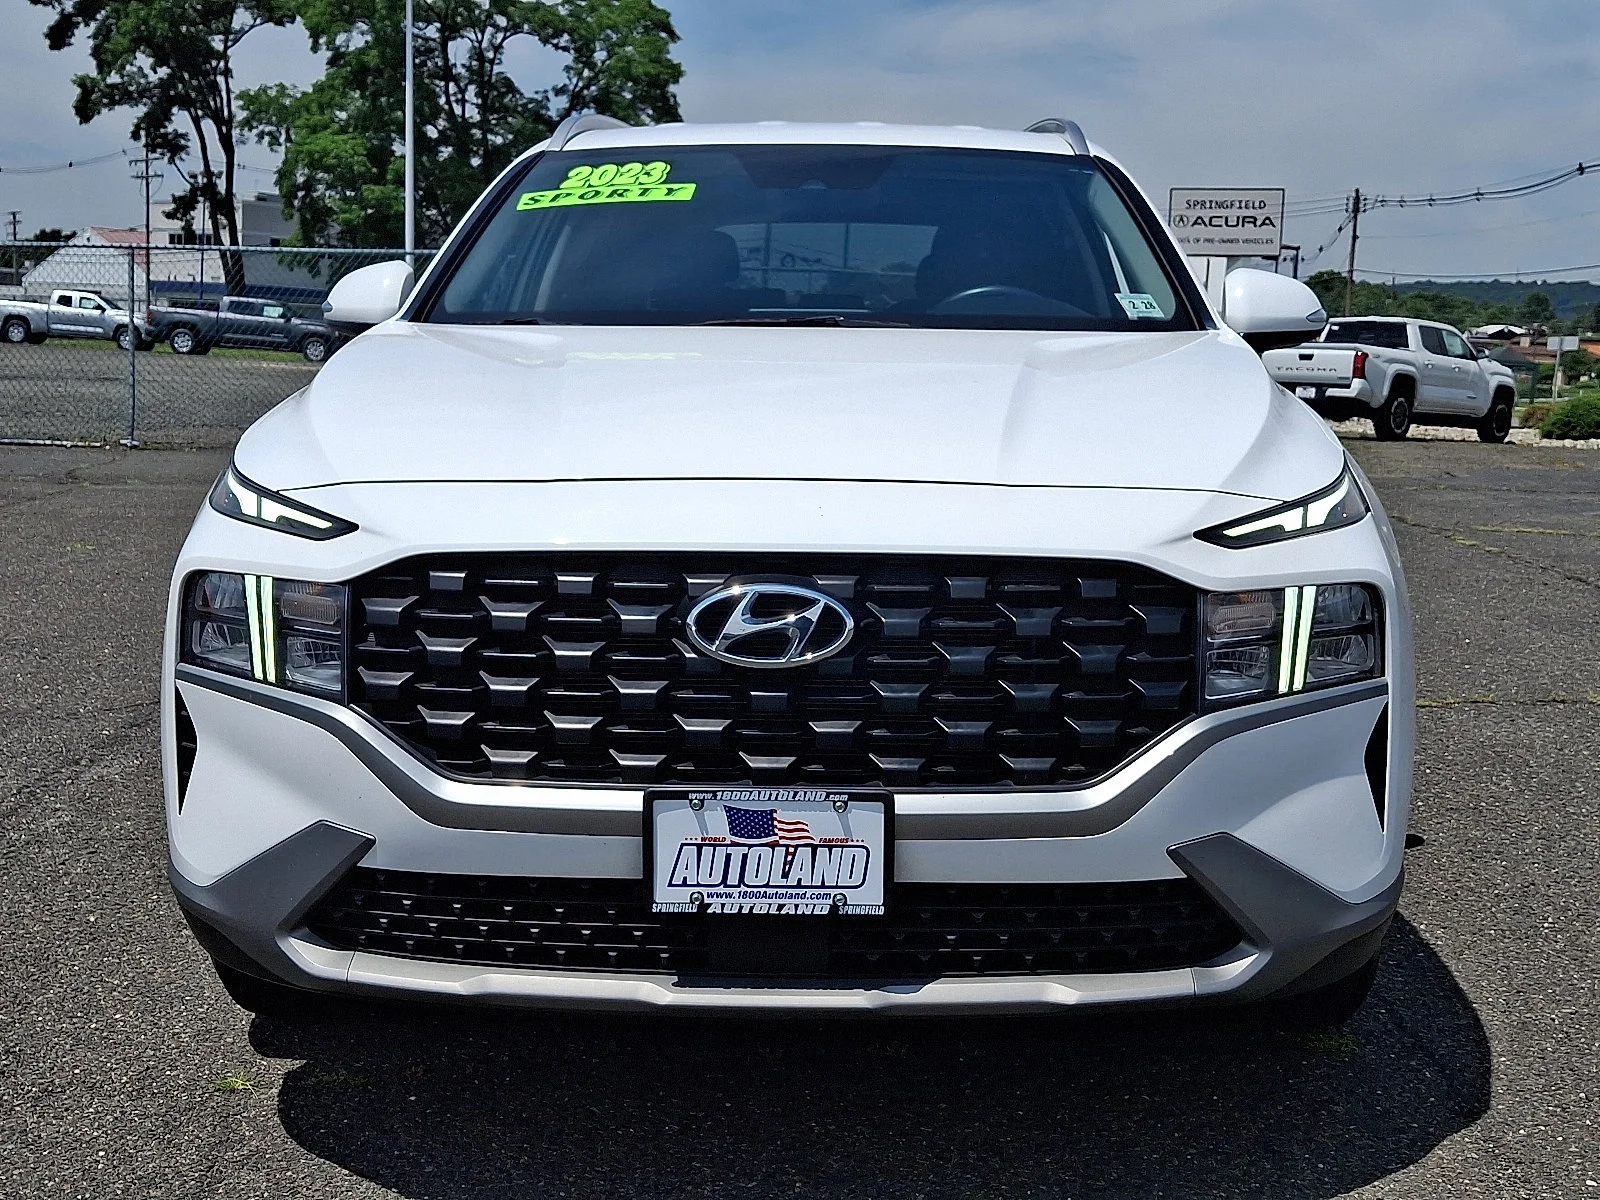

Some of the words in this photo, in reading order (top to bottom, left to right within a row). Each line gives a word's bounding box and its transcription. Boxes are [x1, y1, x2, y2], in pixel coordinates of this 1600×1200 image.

[560, 161, 671, 189] 2023
[523, 187, 686, 206] SPORTY
[1185, 199, 1267, 210] SPRINGFIELD
[1190, 215, 1276, 228] ACURA
[688, 790, 849, 802] www.1800AUTOLAND.com
[668, 844, 870, 888] AUTOLAND
[706, 890, 831, 901] www.1800Autoland.com
[652, 903, 697, 913] SPRINGFIELD
[706, 903, 830, 915] AUTOLAND
[838, 905, 884, 915] SPRINGFIELD
